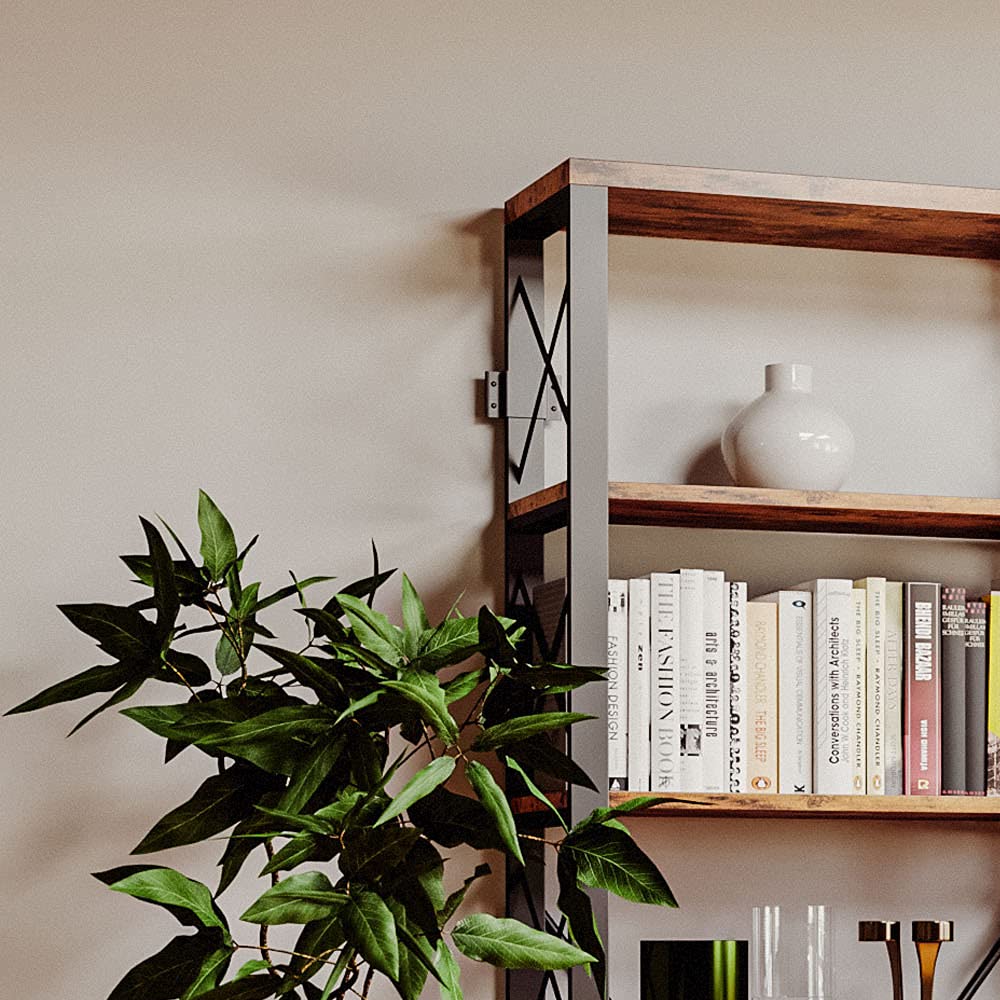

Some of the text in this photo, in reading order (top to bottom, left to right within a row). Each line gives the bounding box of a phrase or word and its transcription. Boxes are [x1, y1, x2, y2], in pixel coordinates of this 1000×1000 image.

[658, 629, 673, 720] FASHION
[706, 632, 717, 653] arts
[608, 635, 618, 740] FASHION DESIGN
[706, 672, 720, 737] architecture
[829, 617, 839, 763] Conversations with Architects
[659, 728, 673, 787] BOOK
